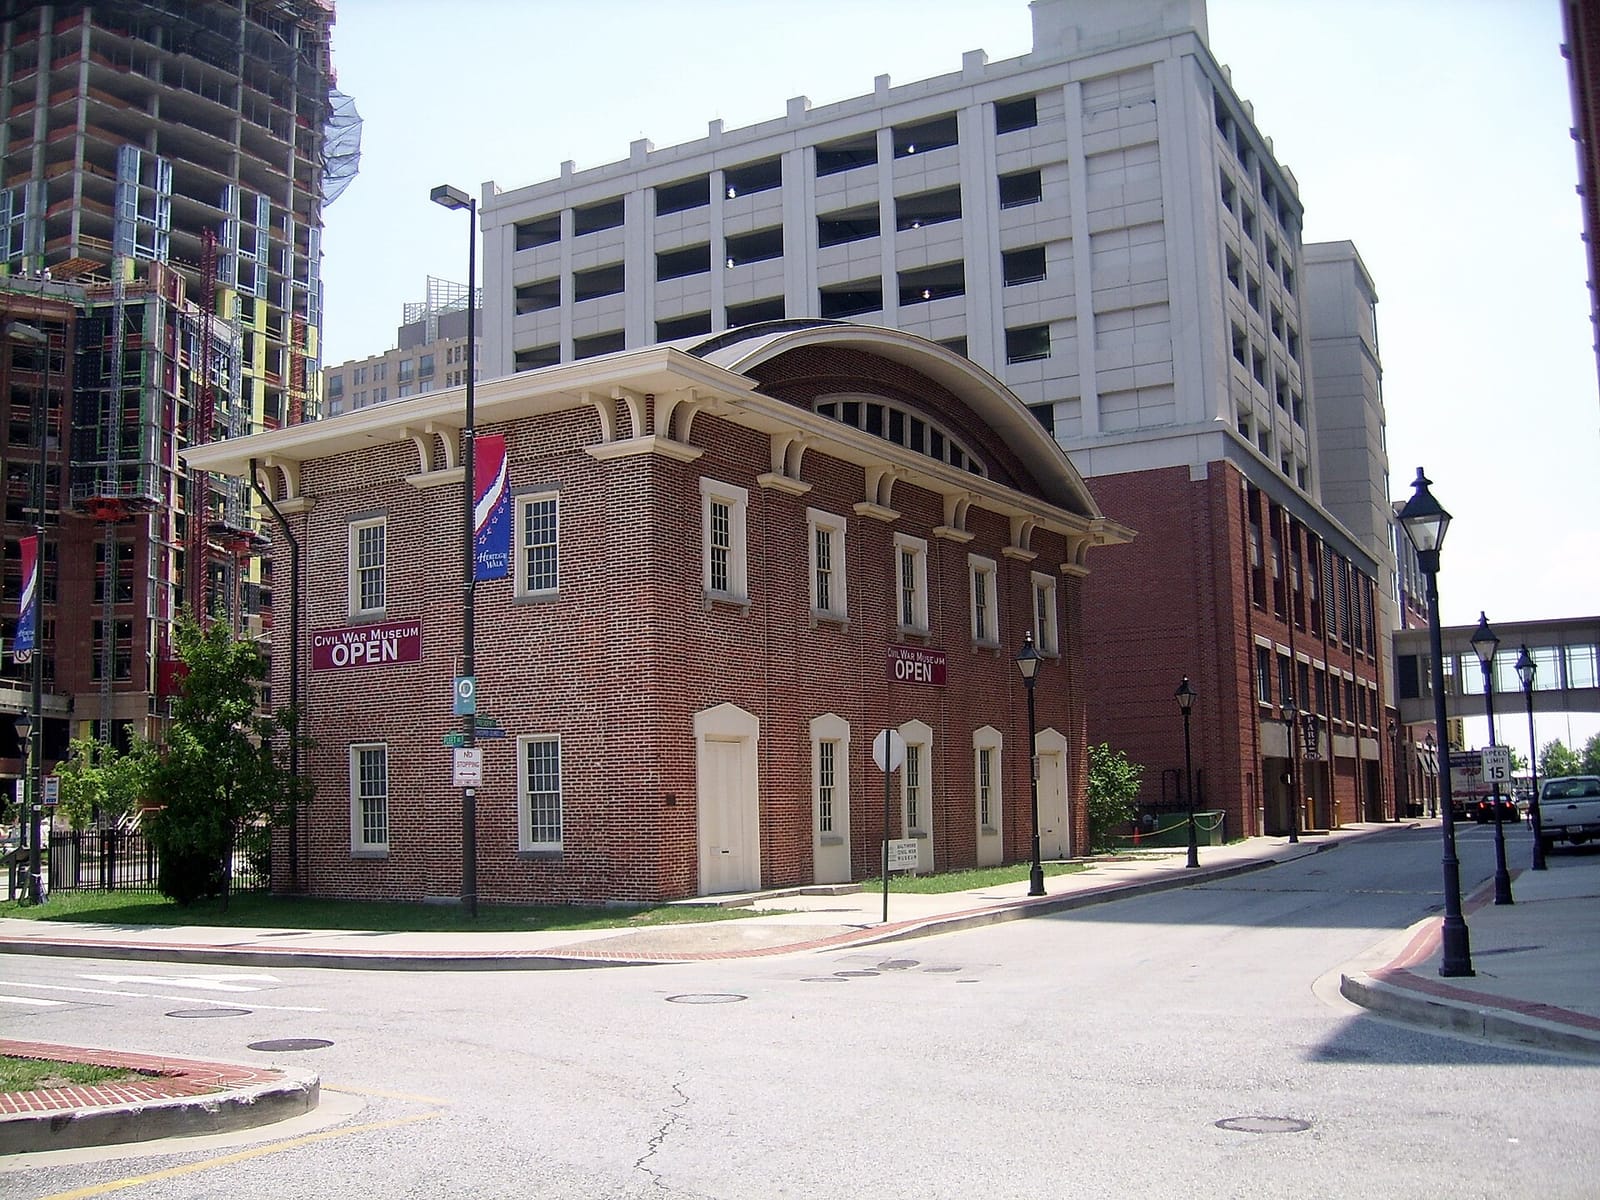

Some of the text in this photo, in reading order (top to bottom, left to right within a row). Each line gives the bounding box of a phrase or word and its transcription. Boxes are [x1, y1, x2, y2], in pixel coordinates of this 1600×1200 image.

[314, 627, 419, 647] CIVIL WAR MUSEUM
[331, 639, 398, 666] OPEN
[887, 647, 945, 665] CIVIL WAR MUSEUM
[895, 659, 932, 682] OPEN
[1488, 766, 1505, 779] 15
